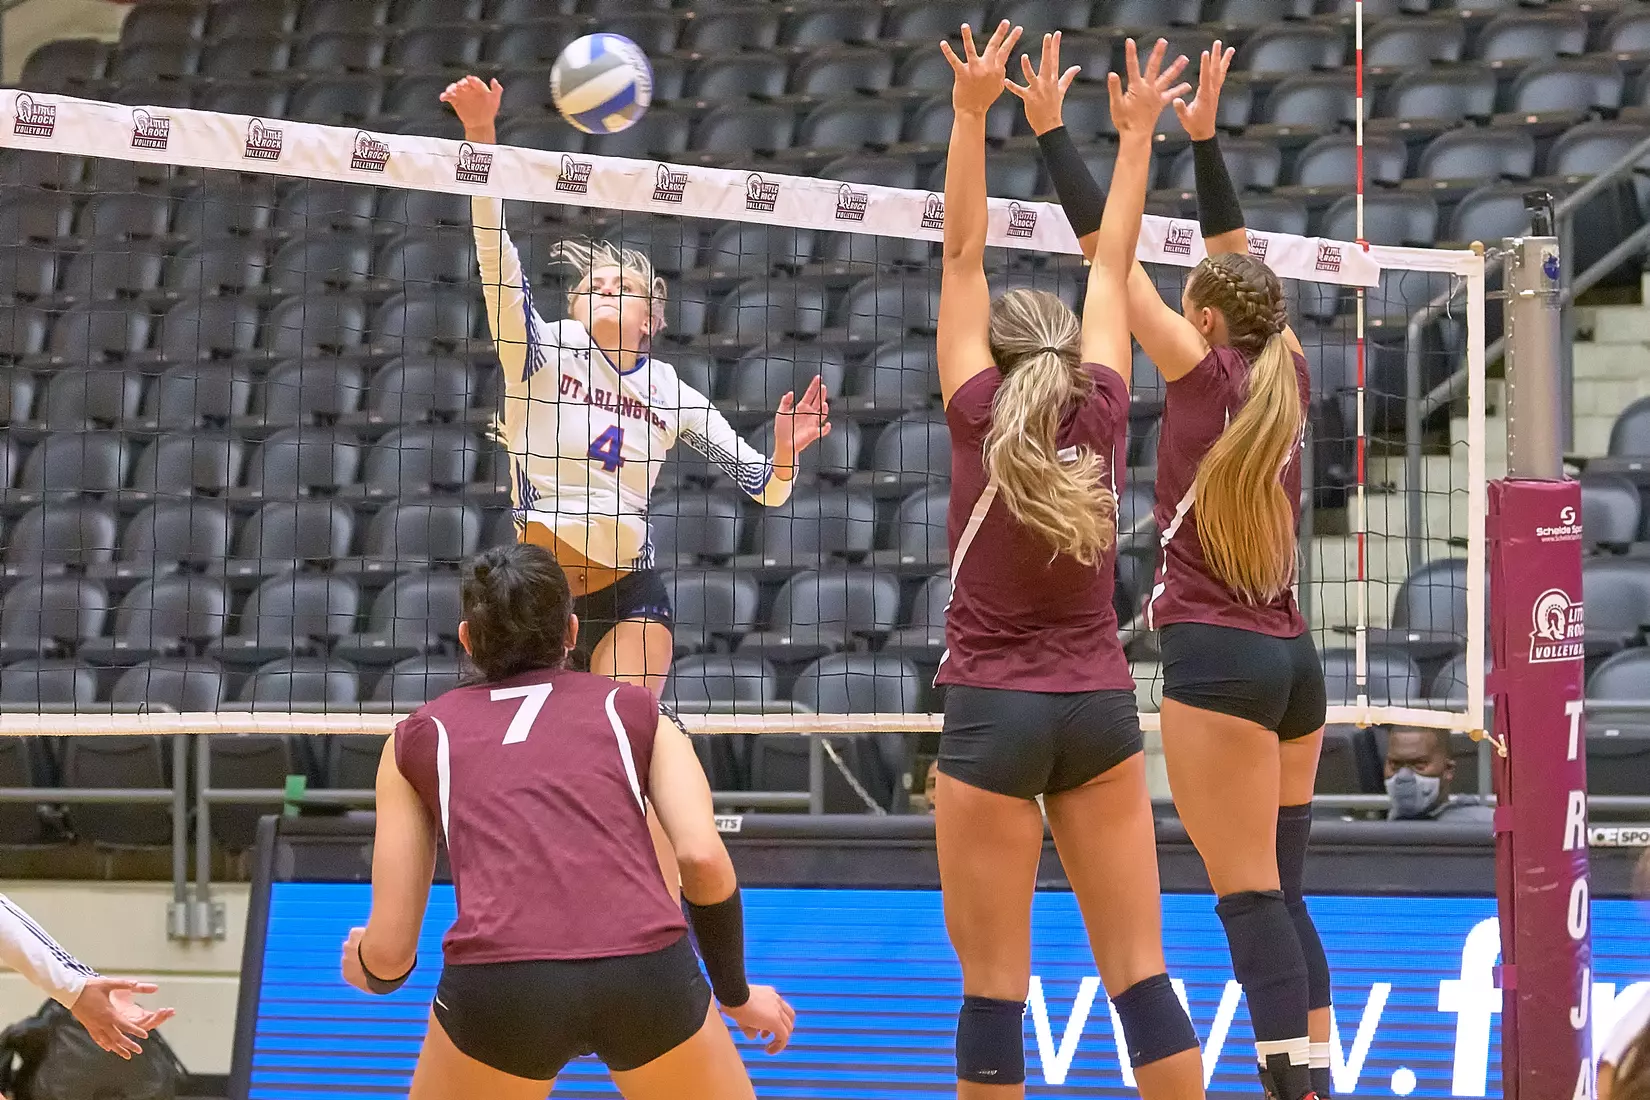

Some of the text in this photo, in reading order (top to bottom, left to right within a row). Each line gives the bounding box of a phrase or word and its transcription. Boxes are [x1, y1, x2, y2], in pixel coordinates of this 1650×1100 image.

[33, 105, 55, 115] LITTLE
[31, 115, 54, 124] ROCK
[149, 118, 169, 128] LITTLE
[15, 125, 51, 136] VOLLEYBALL
[148, 128, 168, 137] ROCK
[263, 130, 282, 139] LITTLE
[134, 138, 166, 149] VOLLEYBALL
[260, 139, 281, 148] ROCK
[367, 150, 390, 160] ROCK
[472, 154, 492, 164] LITTLE
[470, 164, 490, 172] ROCK
[574, 164, 592, 173] LITTLE
[572, 173, 589, 182] ROCK
[670, 173, 687, 182] LITTLE
[668, 182, 685, 191] ROCK
[762, 183, 779, 193] LITTLE
[760, 192, 777, 201] ROCK
[851, 194, 867, 202] LITTLE
[850, 202, 865, 210] ROCK
[935, 211, 944, 219] RO
[1018, 211, 1037, 220] LITTLE
[1017, 220, 1034, 228] ROCK
[560, 373, 583, 398] UT
[587, 424, 626, 473] 4
[1568, 607, 1583, 623] LITT
[1567, 623, 1584, 638] ROC
[1536, 643, 1584, 658] VOLLEYBA
[490, 683, 553, 745] 7
[715, 819, 738, 829] RTS
[1621, 831, 1649, 842] SPO
[1563, 701, 1592, 1100] TROJA
